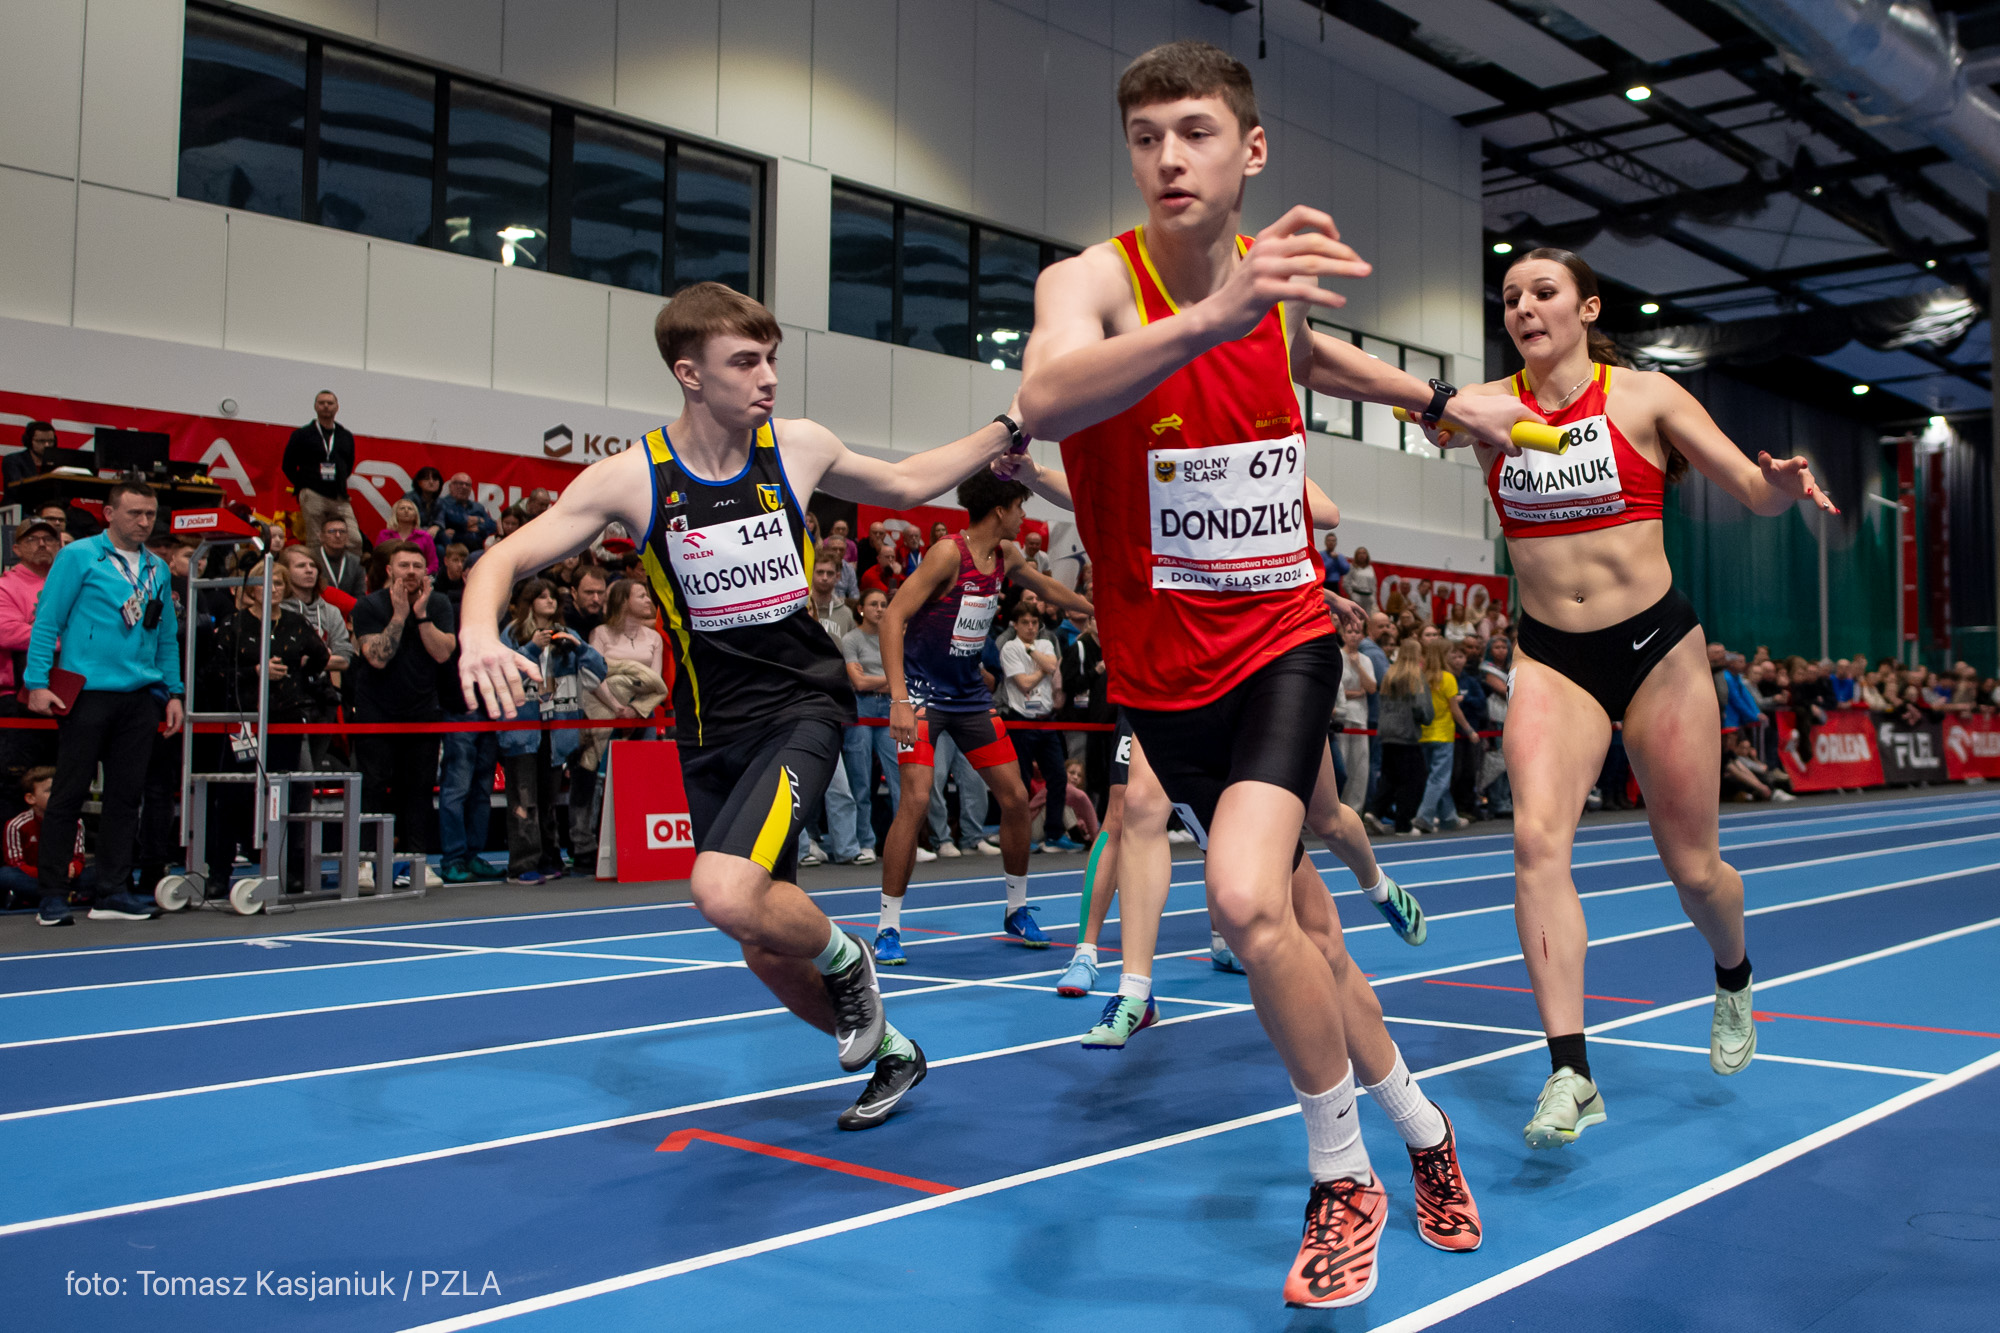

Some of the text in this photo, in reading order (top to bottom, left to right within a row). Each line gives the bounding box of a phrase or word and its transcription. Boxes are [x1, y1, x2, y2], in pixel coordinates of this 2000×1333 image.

[584, 433, 632, 457] KG
[1183, 456, 1230, 471] DOLNY
[1249, 445, 1297, 479] 679
[1503, 456, 1614, 494] ROMANIUK
[1160, 498, 1302, 541] DONDZIŁO
[1514, 505, 1613, 521] DOLNY ŚLĄSK 2024
[737, 517, 783, 546] 144
[683, 549, 714, 560] ORLEN
[1211, 560, 1260, 571] Mistrzostwa
[1262, 556, 1285, 567] Polski
[679, 553, 799, 596] KŁOSOWSKI
[1171, 567, 1301, 589] DOLNY ŚLĄSK 2024
[700, 603, 799, 628] DOLNY ŚLĄSK 2024
